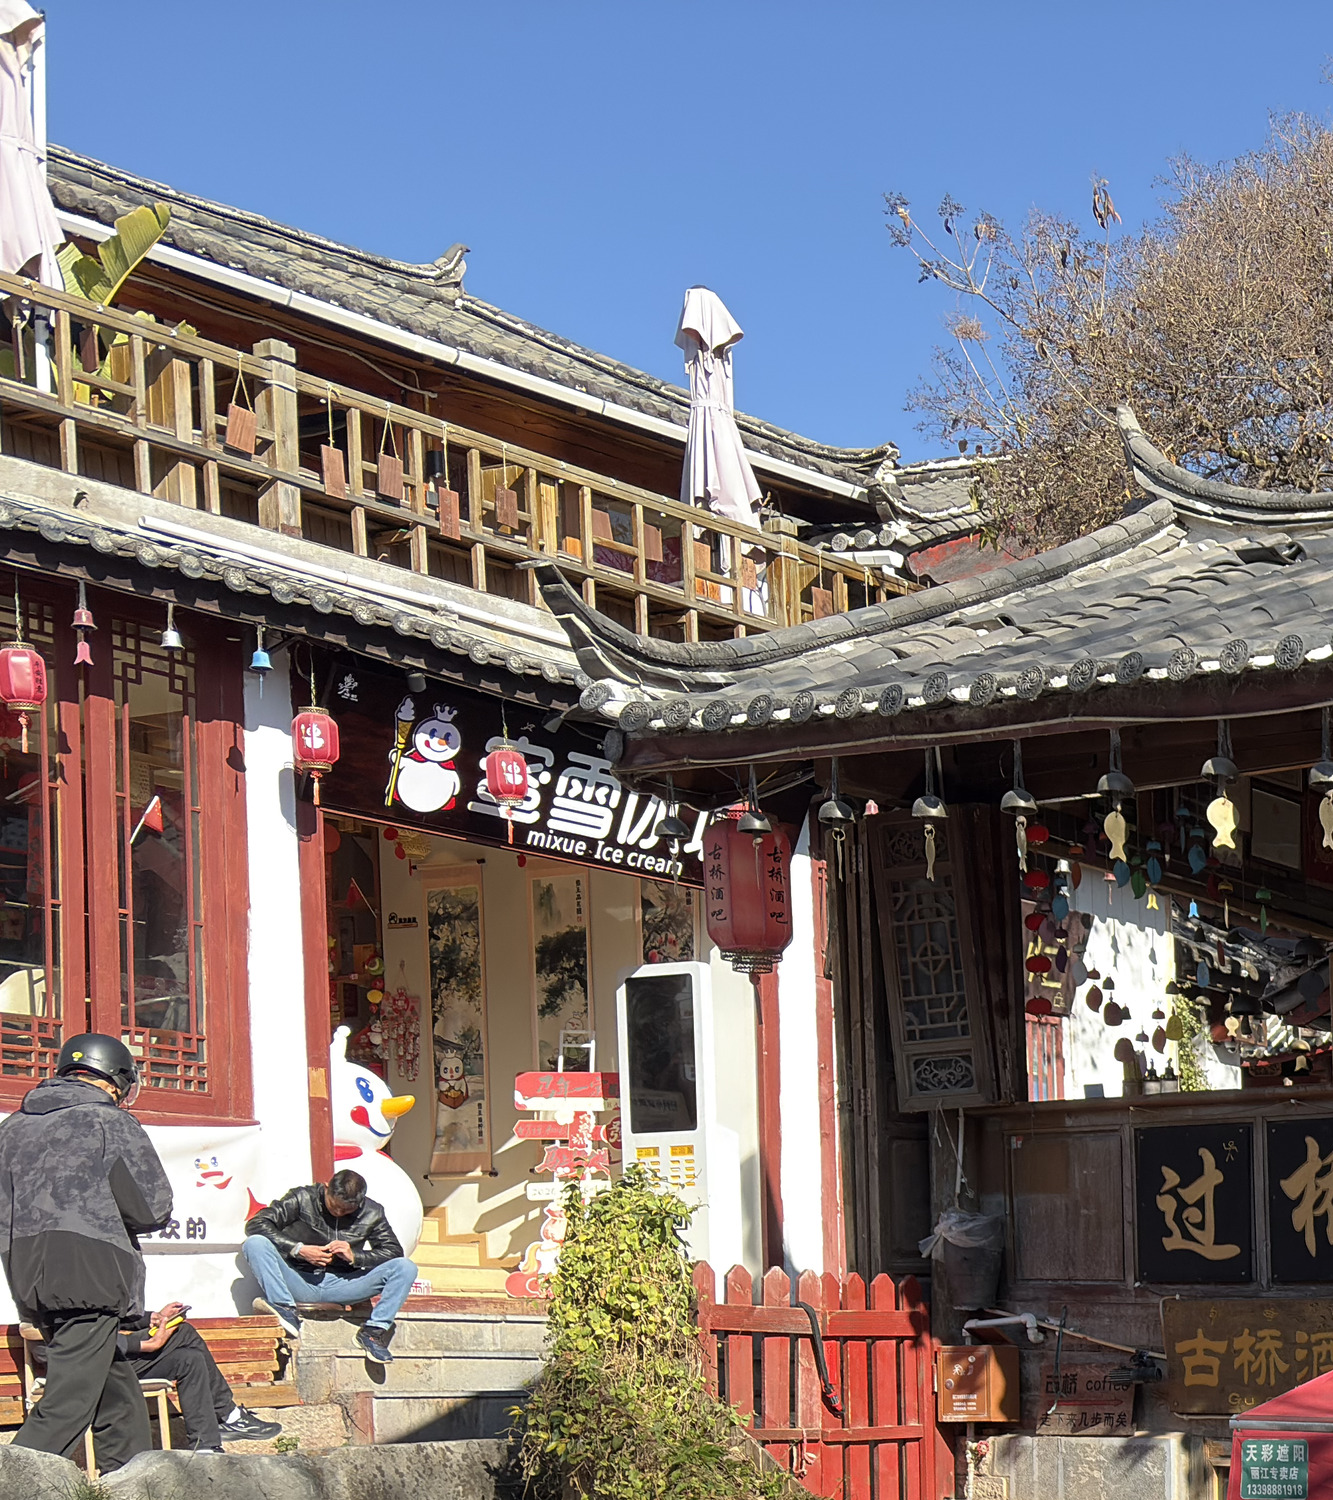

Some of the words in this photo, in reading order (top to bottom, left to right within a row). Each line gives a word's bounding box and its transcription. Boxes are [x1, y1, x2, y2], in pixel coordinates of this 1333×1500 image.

[467, 736, 704, 861] 蜜雪冰
[527, 830, 586, 856] mixue
[594, 840, 625, 863] Ice
[627, 851, 684, 875] cream
[707, 843, 727, 921] 古桥酒吧
[766, 847, 788, 924] 古桥酒吧
[142, 1217, 207, 1240] 欢的
[1039, 1411, 1127, 1428] 走下来几步而矣
[1246, 1444, 1305, 1462] 天彩遮阳
[1250, 1466, 1299, 1480] 丽江专卖店
[1247, 1484, 1303, 1496] 13398881918
